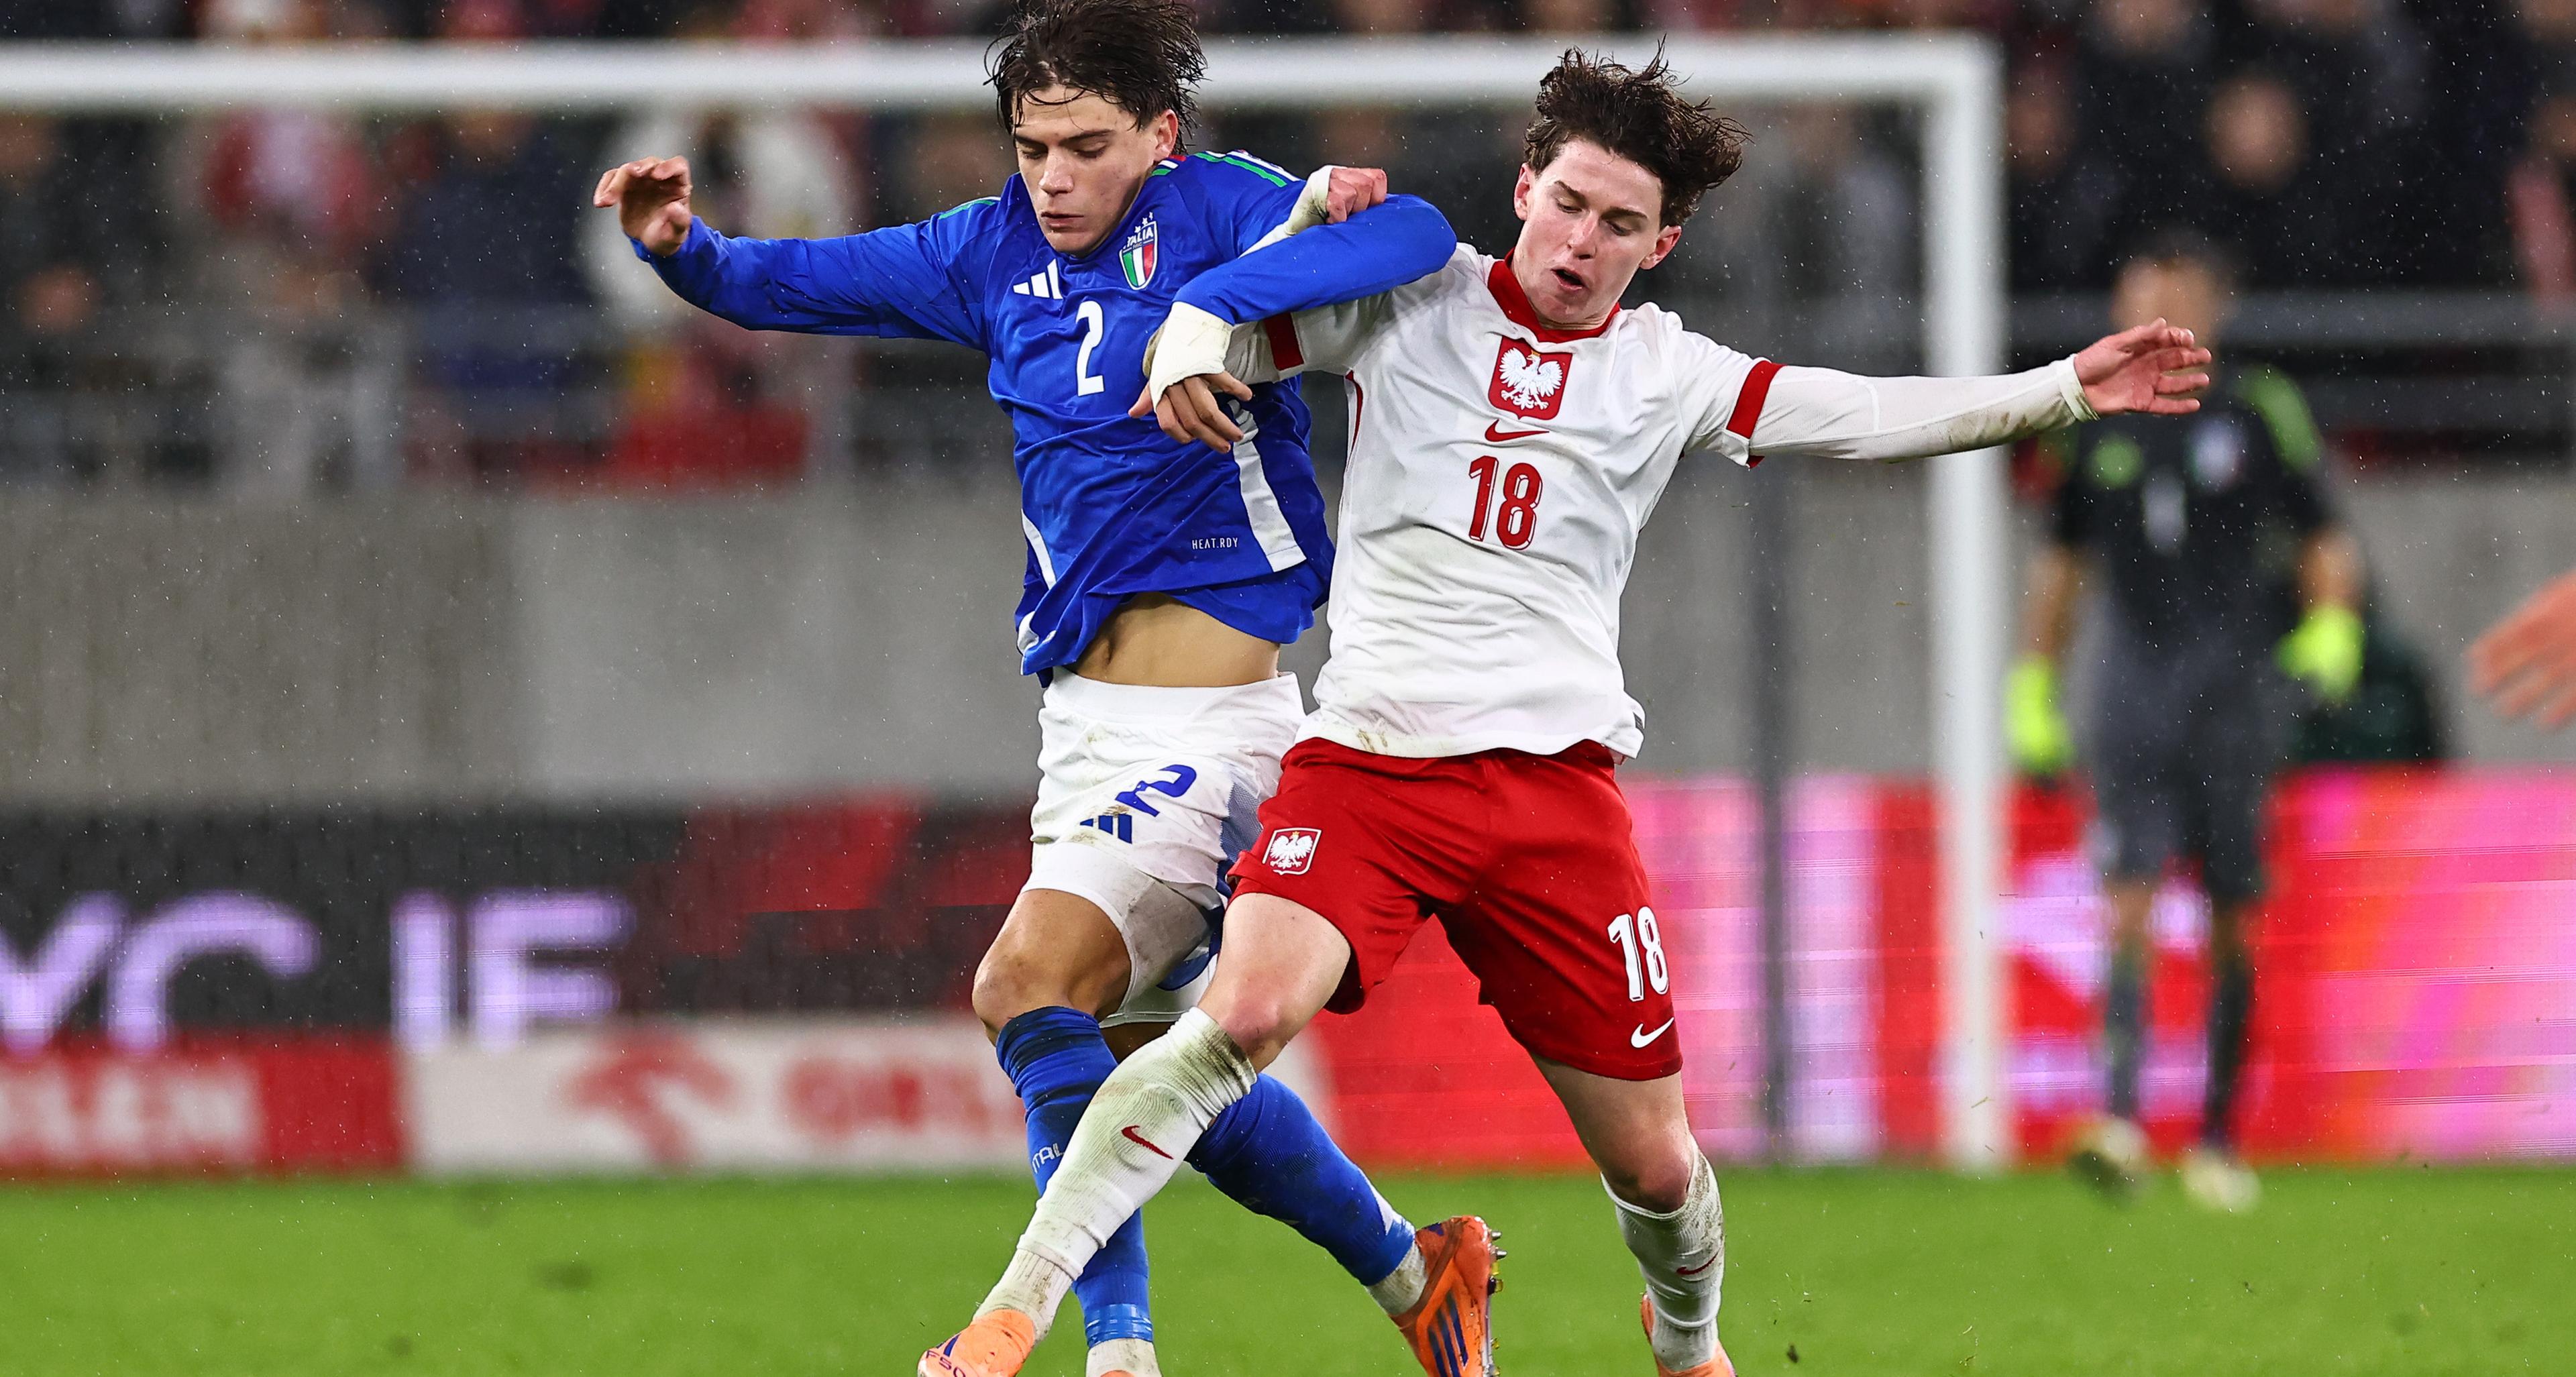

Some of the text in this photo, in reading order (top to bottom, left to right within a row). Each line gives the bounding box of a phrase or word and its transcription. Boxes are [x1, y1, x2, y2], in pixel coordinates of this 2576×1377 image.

[1075, 300, 1105, 397] 2
[1191, 537, 1238, 550] HEAT.RDY
[1468, 455, 1543, 551] 18
[1114, 764, 1197, 818] 2
[1607, 906, 1669, 1002] 18
